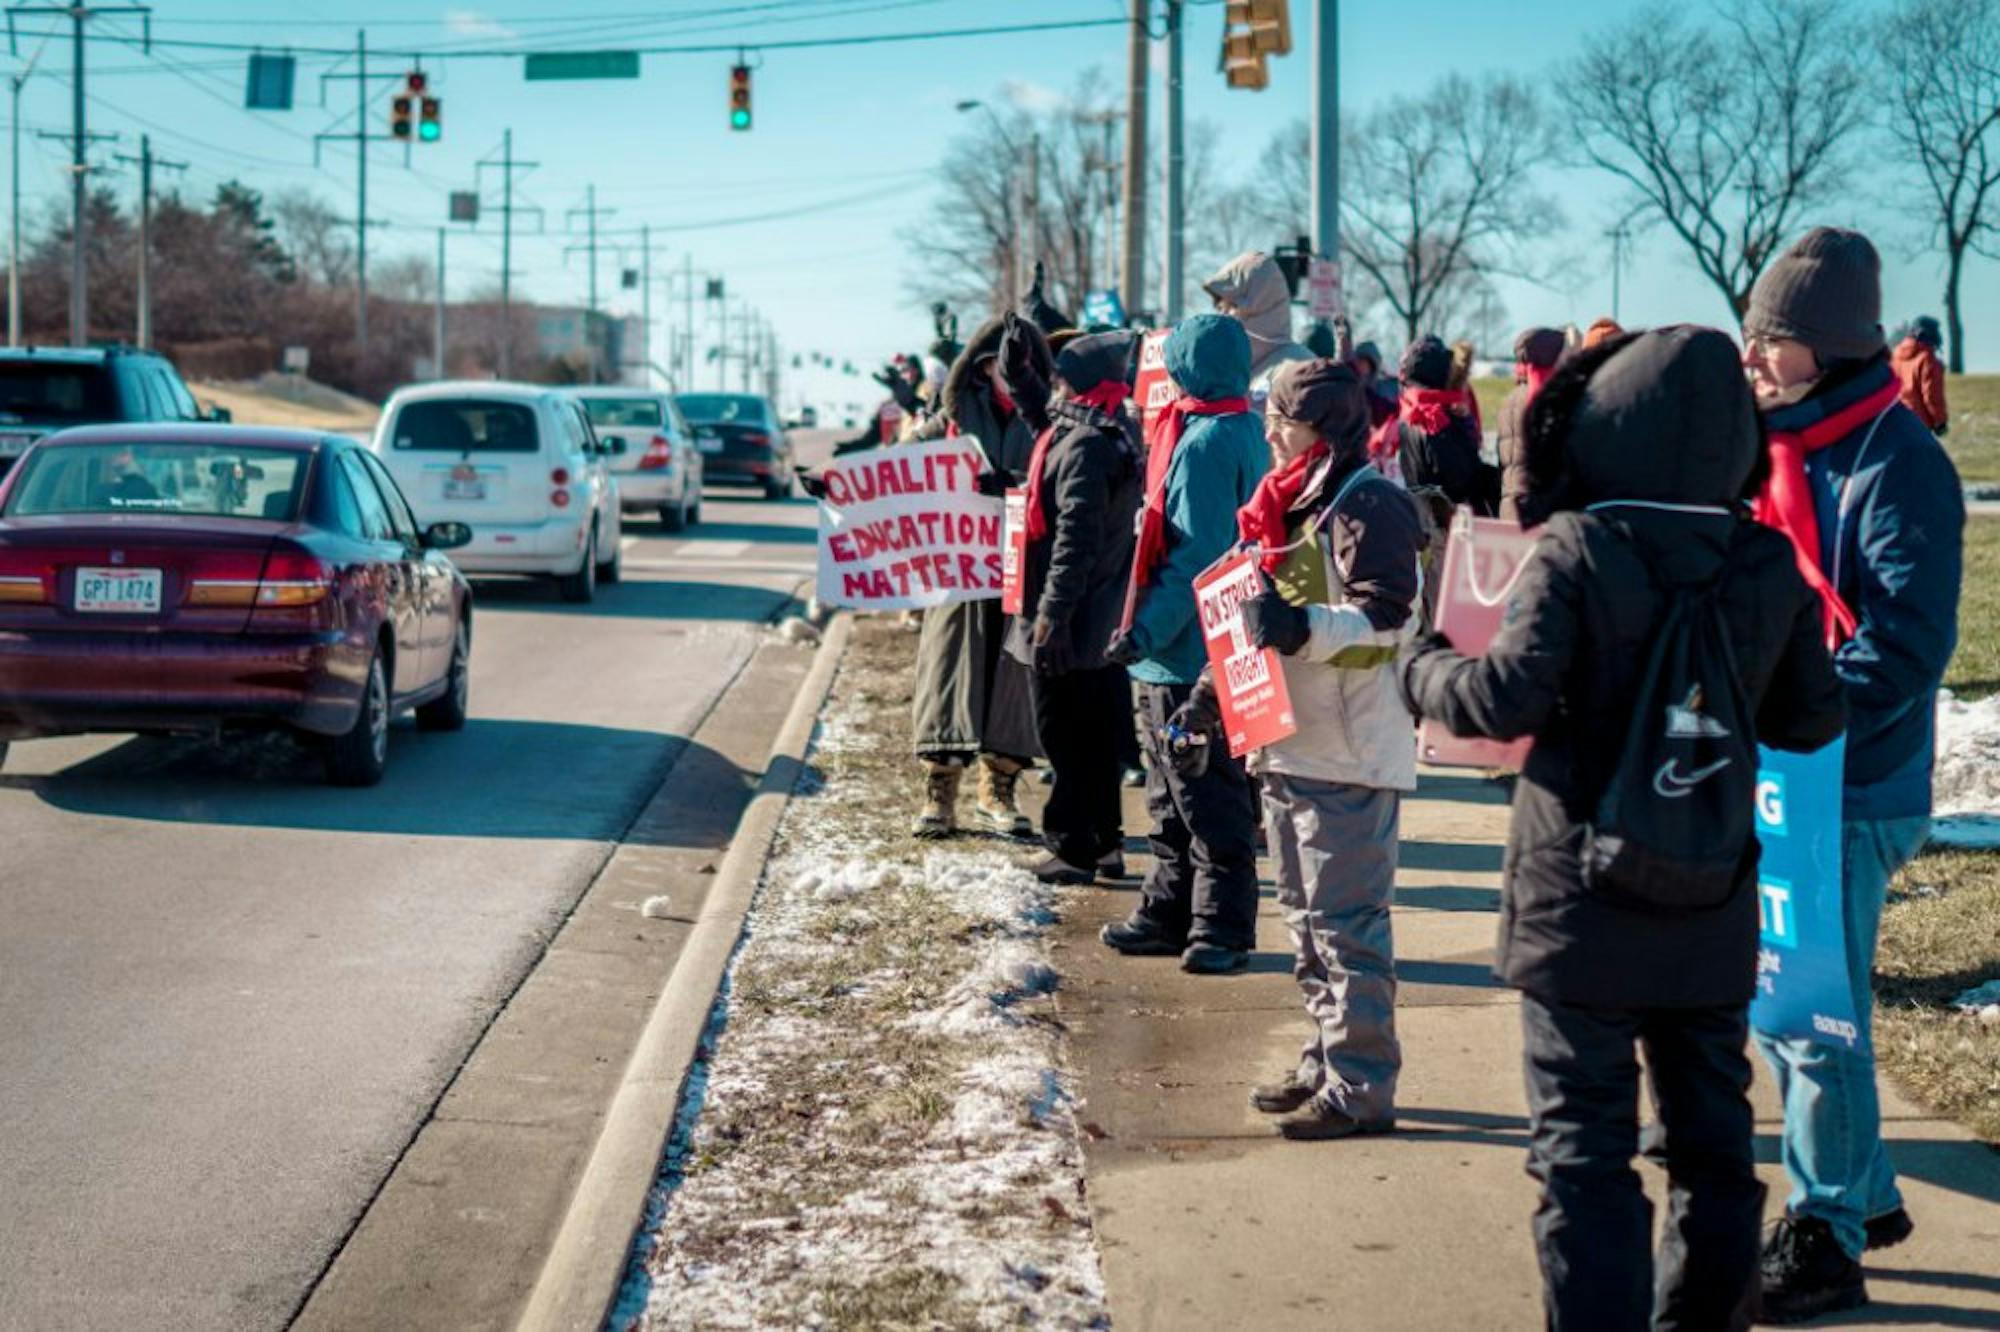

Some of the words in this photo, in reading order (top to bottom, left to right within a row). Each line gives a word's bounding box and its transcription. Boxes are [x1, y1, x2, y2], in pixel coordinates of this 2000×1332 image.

[823, 451, 985, 506] QUALITY
[828, 511, 1000, 563] EDUCATION
[83, 580, 109, 600] GPT
[117, 580, 154, 601] 1474
[843, 551, 1003, 600] MATTERS
[1202, 595, 1222, 629] ON
[1220, 573, 1259, 623] STRIKE
